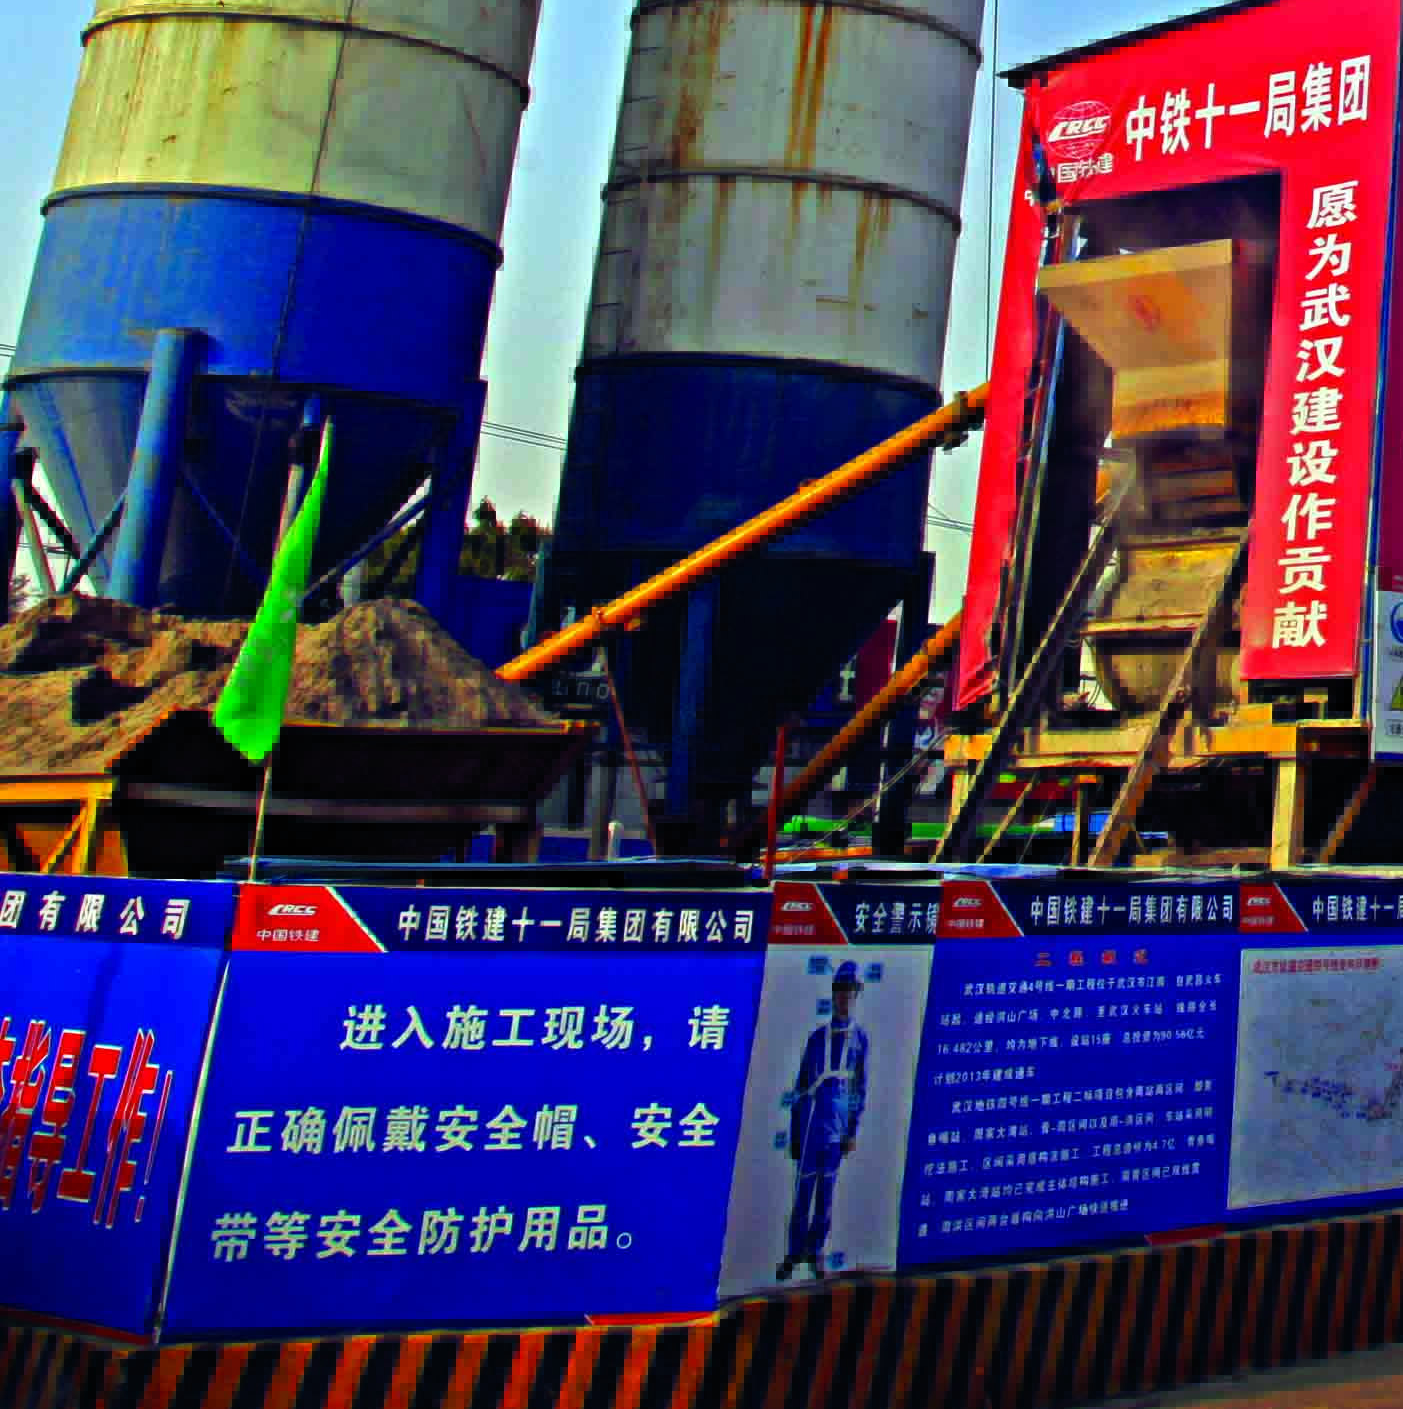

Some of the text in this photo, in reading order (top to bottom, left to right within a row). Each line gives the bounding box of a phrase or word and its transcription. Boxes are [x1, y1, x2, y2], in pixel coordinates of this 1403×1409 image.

[1125, 54, 1371, 162] 中铁十一局集团
[1047, 115, 1112, 142] CRCC
[1049, 152, 1114, 183] 国铁建
[1272, 179, 1359, 649] 愿为武汉建设作贡献
[267, 903, 317, 917] CRCC
[397, 904, 756, 944] 中国铁建十一局集团有限公司
[1030, 894, 1234, 927] 中国铁建十一局集团有限公司
[256, 928, 321, 943] 中国铁建
[340, 1004, 731, 1053] 进入施工现场，请
[226, 1103, 721, 1156] 正确佩戴安全帽、安全
[209, 1204, 635, 1264] 带等安全防护用品。
